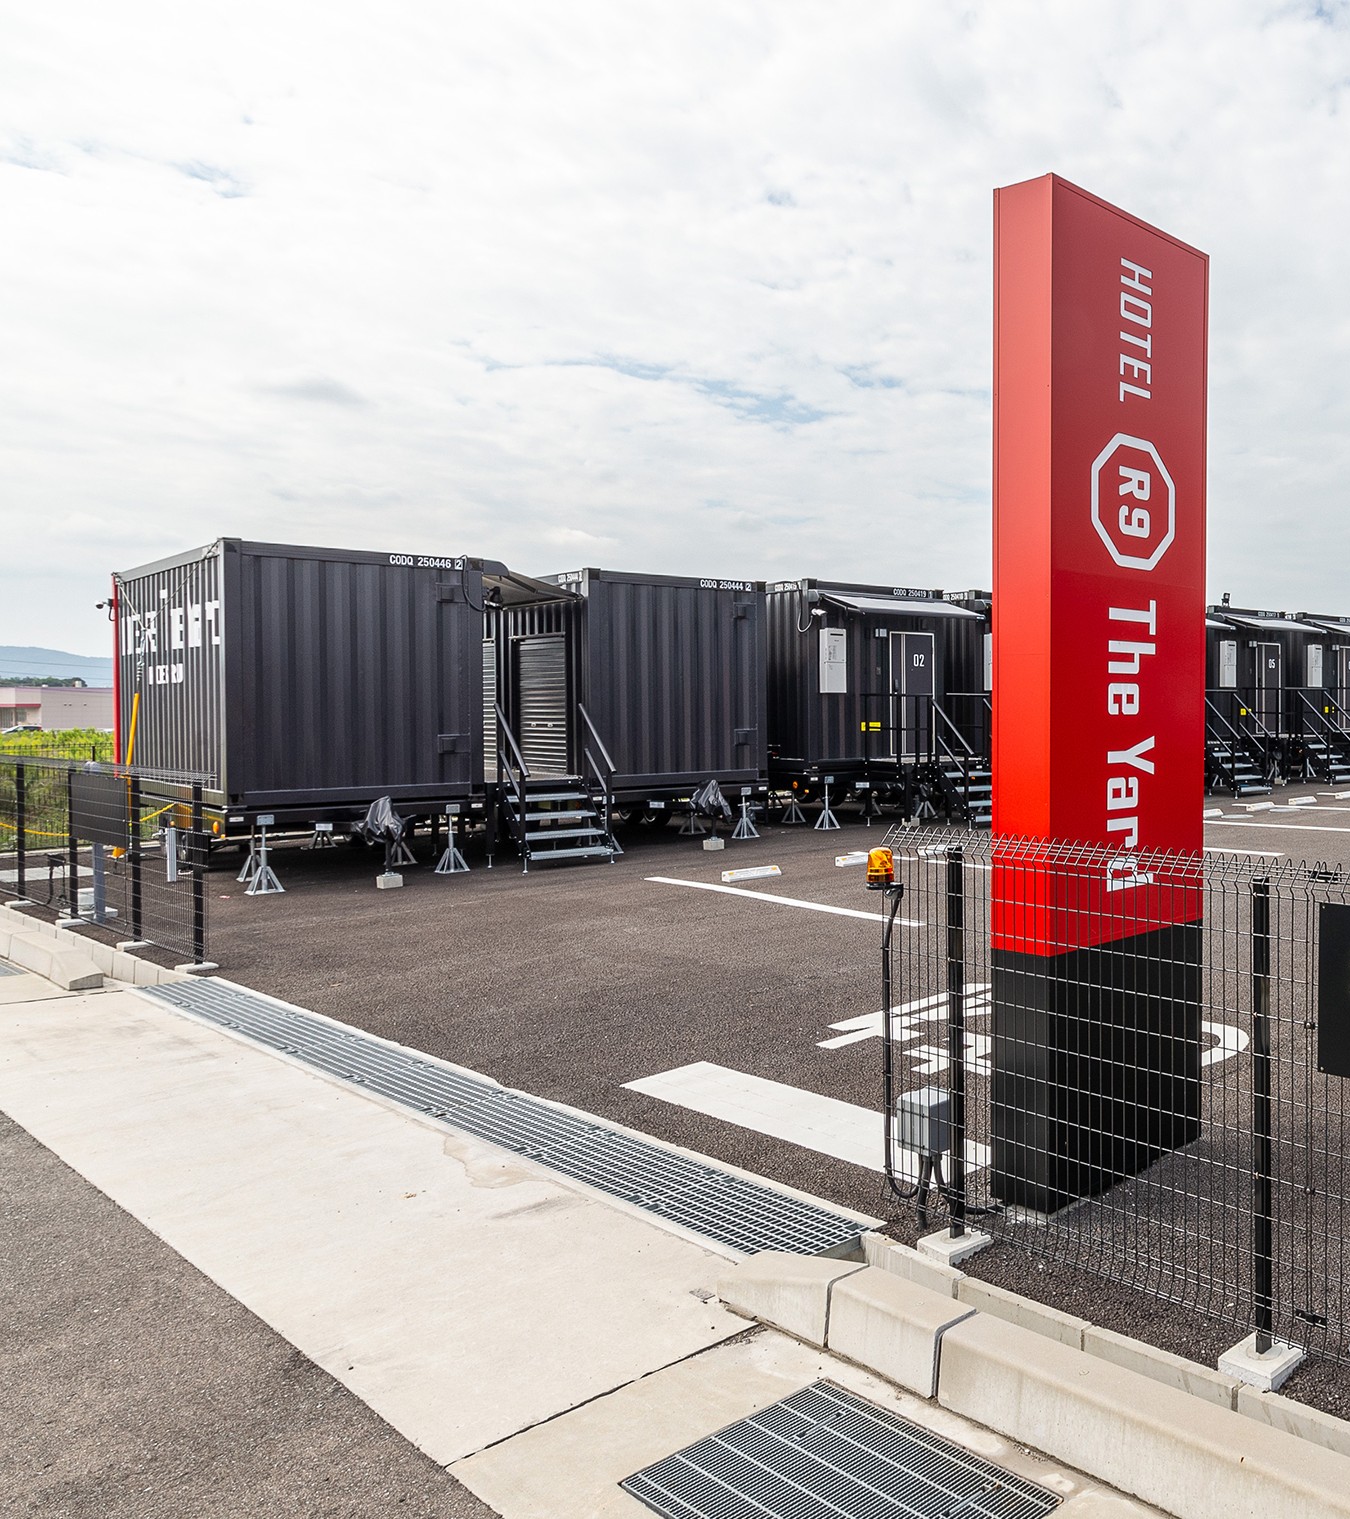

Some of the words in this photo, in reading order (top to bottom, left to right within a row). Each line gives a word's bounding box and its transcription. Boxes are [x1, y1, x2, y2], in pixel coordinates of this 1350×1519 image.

[1118, 256, 1153, 403] HOTEL
[1117, 464, 1151, 540] R9
[417, 556, 452, 569] 250446
[719, 580, 744, 591] 250444
[913, 654, 925, 667] 02
[1107, 598, 1157, 716] The
[1268, 658, 1276, 669] 05
[1105, 734, 1156, 893] Yard
